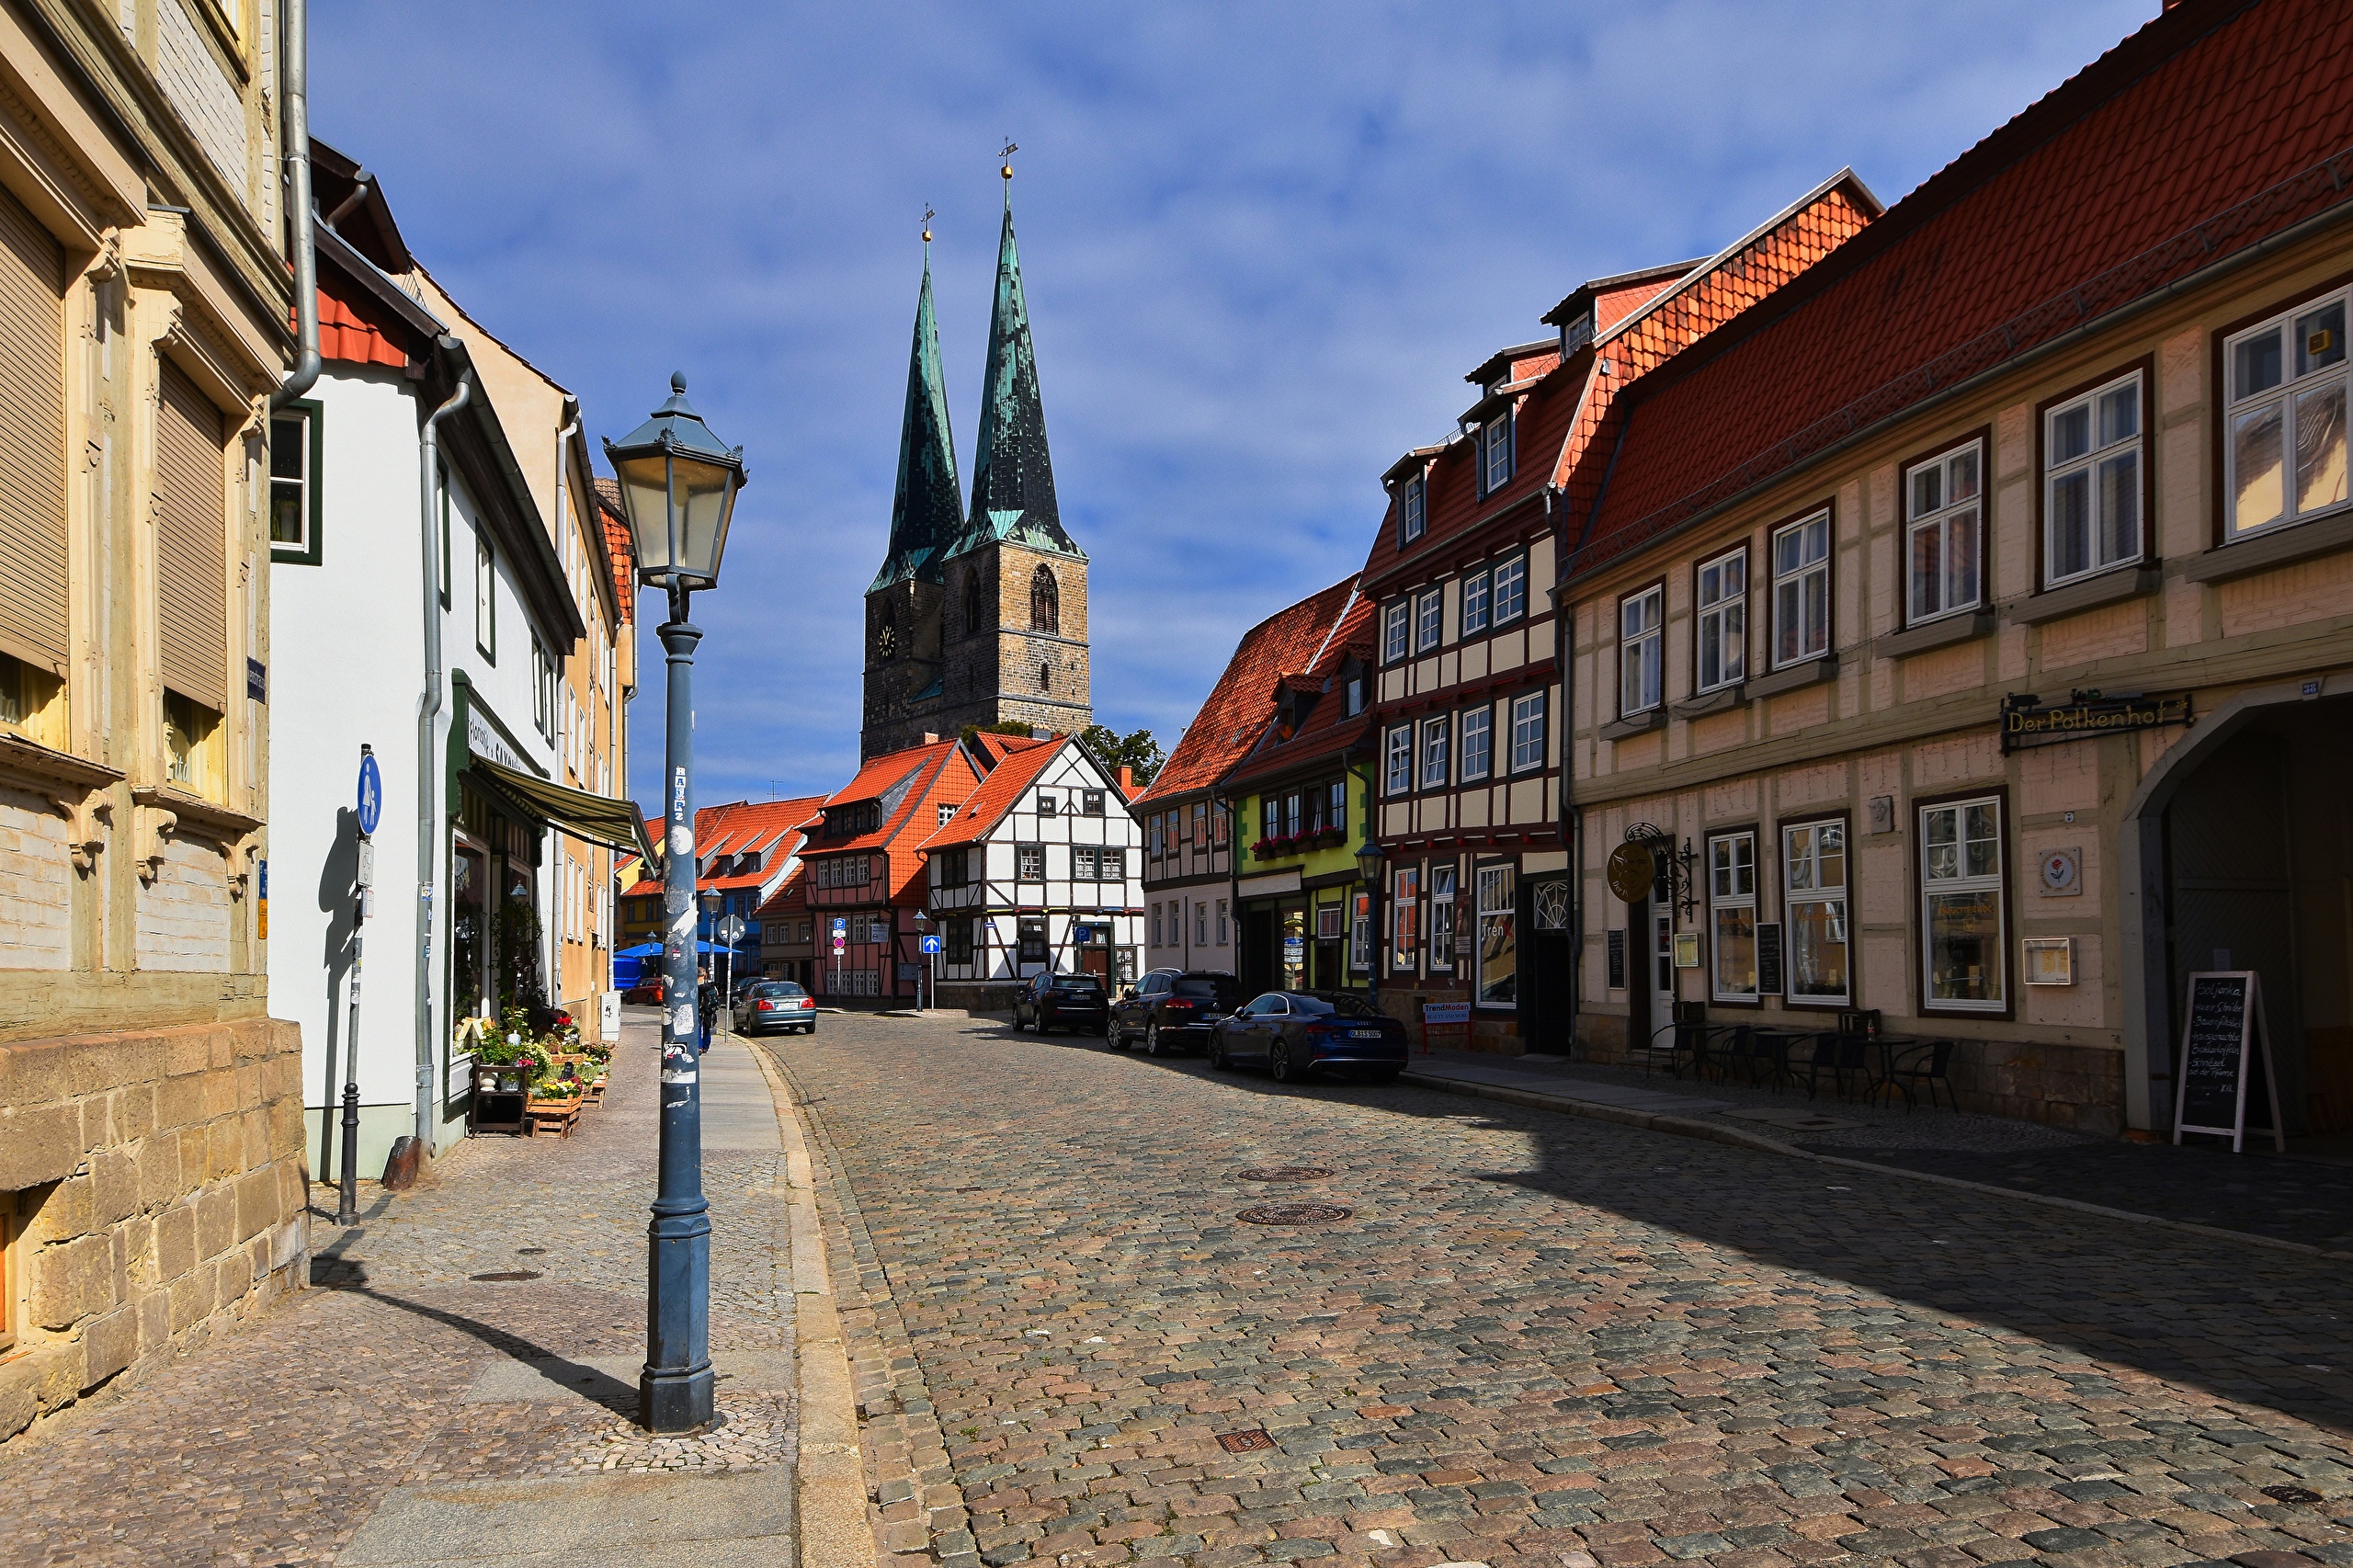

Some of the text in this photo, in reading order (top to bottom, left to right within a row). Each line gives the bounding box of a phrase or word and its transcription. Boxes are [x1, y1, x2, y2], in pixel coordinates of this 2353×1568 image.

[2008, 712, 2046, 733] Der
[1079, 929, 1086, 940] P
[1426, 1004, 1469, 1012] TrendModen
